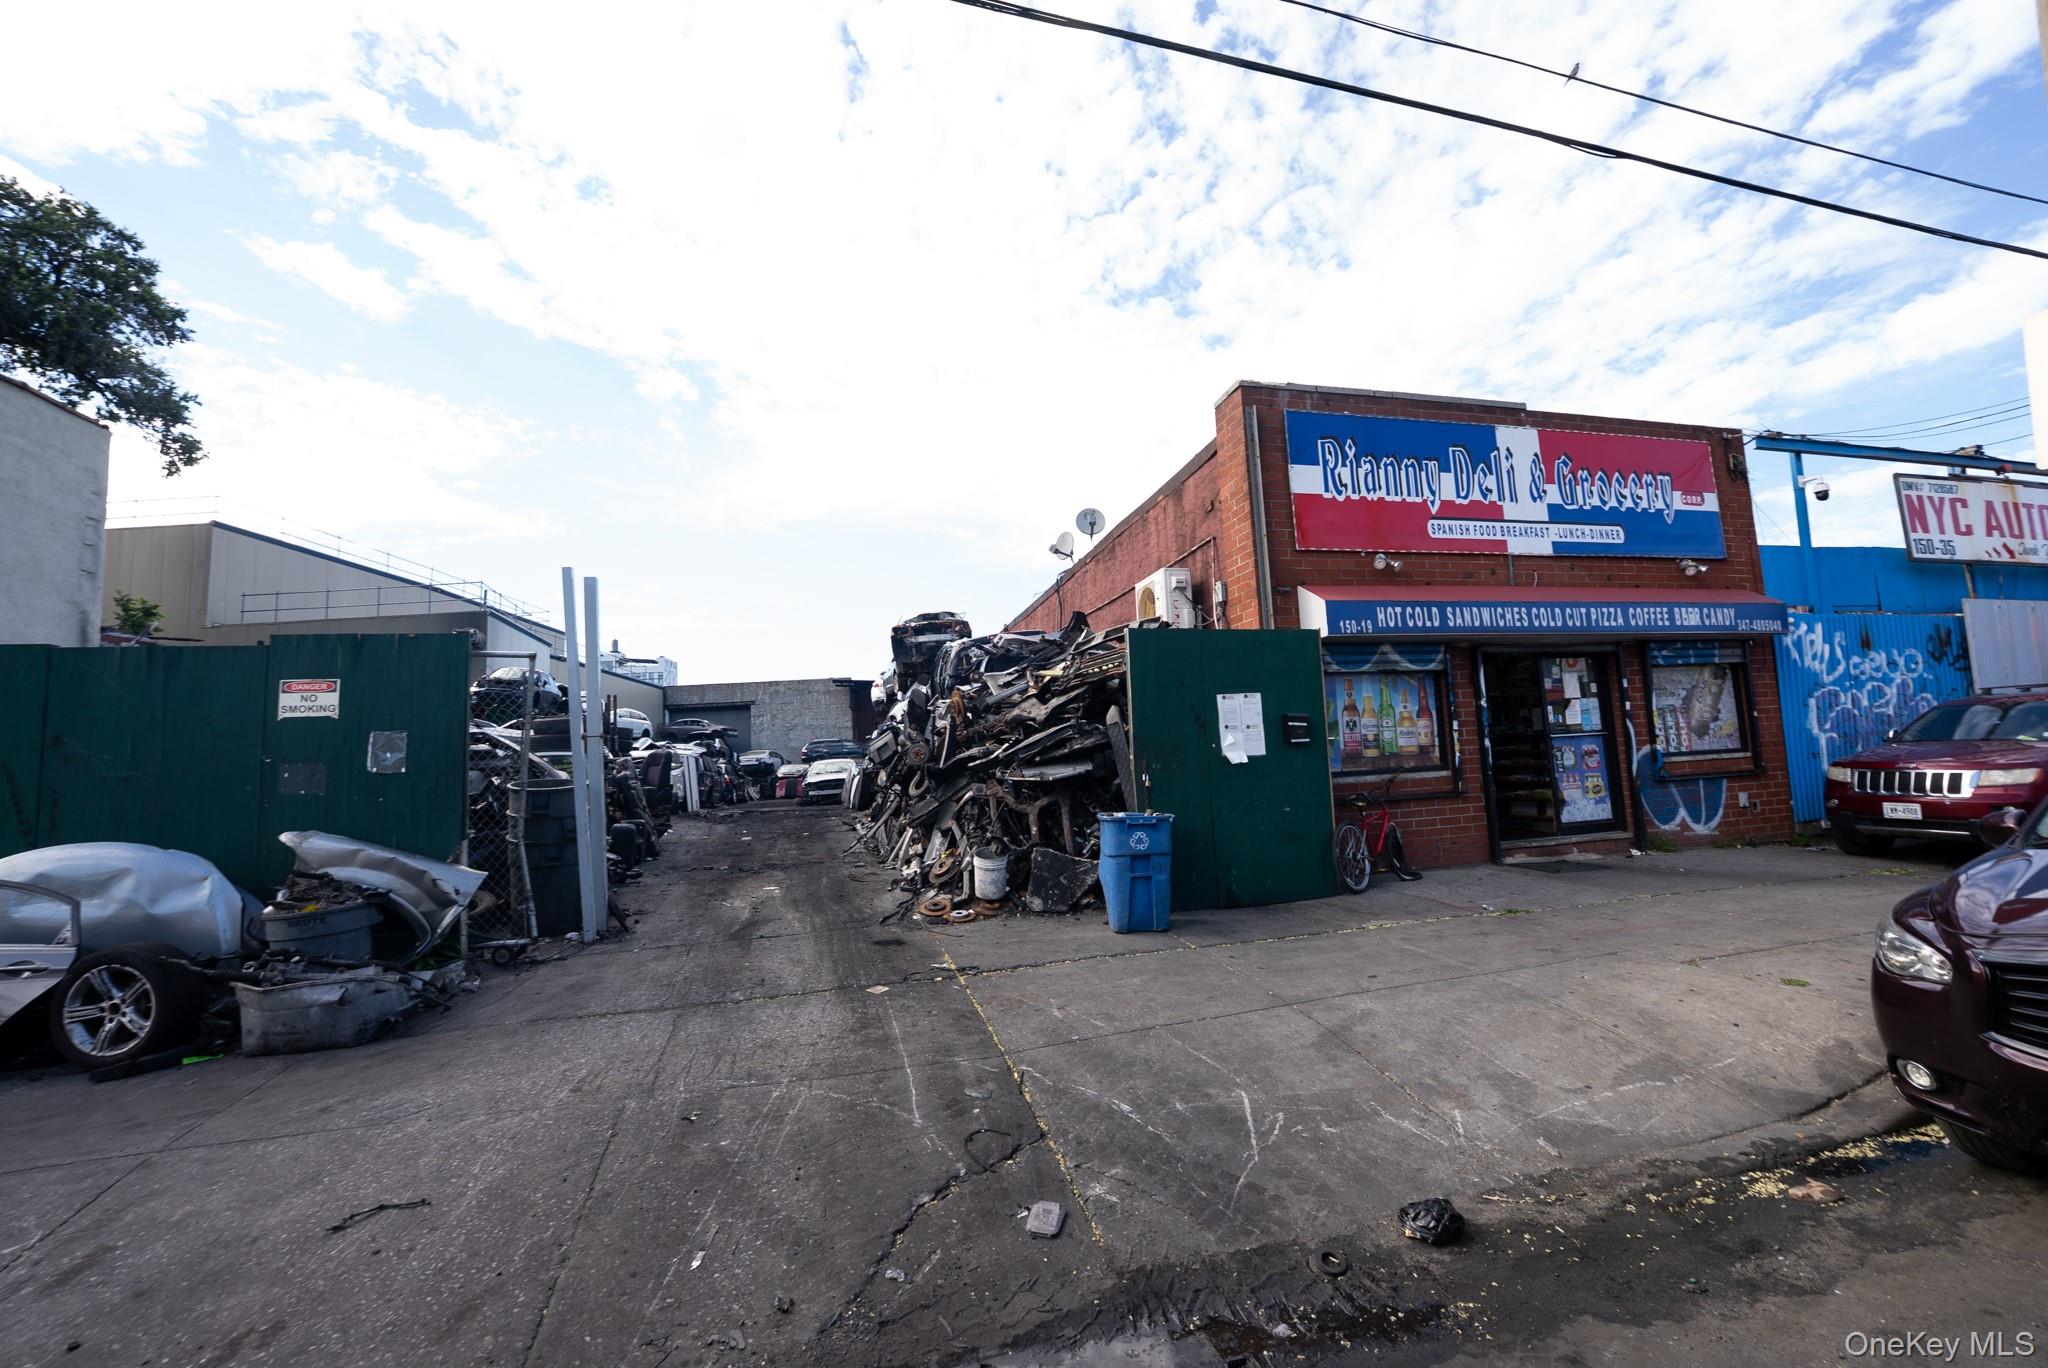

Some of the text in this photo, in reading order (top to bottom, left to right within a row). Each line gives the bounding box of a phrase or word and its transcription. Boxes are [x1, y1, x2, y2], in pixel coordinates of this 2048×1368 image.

[1317, 436, 1676, 524] Rianny Deli & Grocery
[1904, 493, 1974, 537] NYC
[1430, 522, 1471, 537] SPANISH
[1473, 524, 1498, 538] FOOD
[1500, 525, 1550, 539] BREAKFAST
[1912, 538, 1957, 556] 150-35
[1339, 619, 1373, 634] 150-19
[1376, 606, 1402, 628] HOT
[1405, 606, 1441, 628] COLD
[1447, 606, 1529, 628] SANDWICHES
[1531, 606, 1563, 627] COLD
[1565, 607, 1587, 627] CUT
[1590, 607, 1625, 627] PIZZA
[1628, 607, 1671, 626] COFFEE
[1703, 607, 1736, 626] CANDY
[291, 682, 328, 691] DANGER
[300, 694, 318, 703] NO
[280, 704, 337, 714] SMOKING
